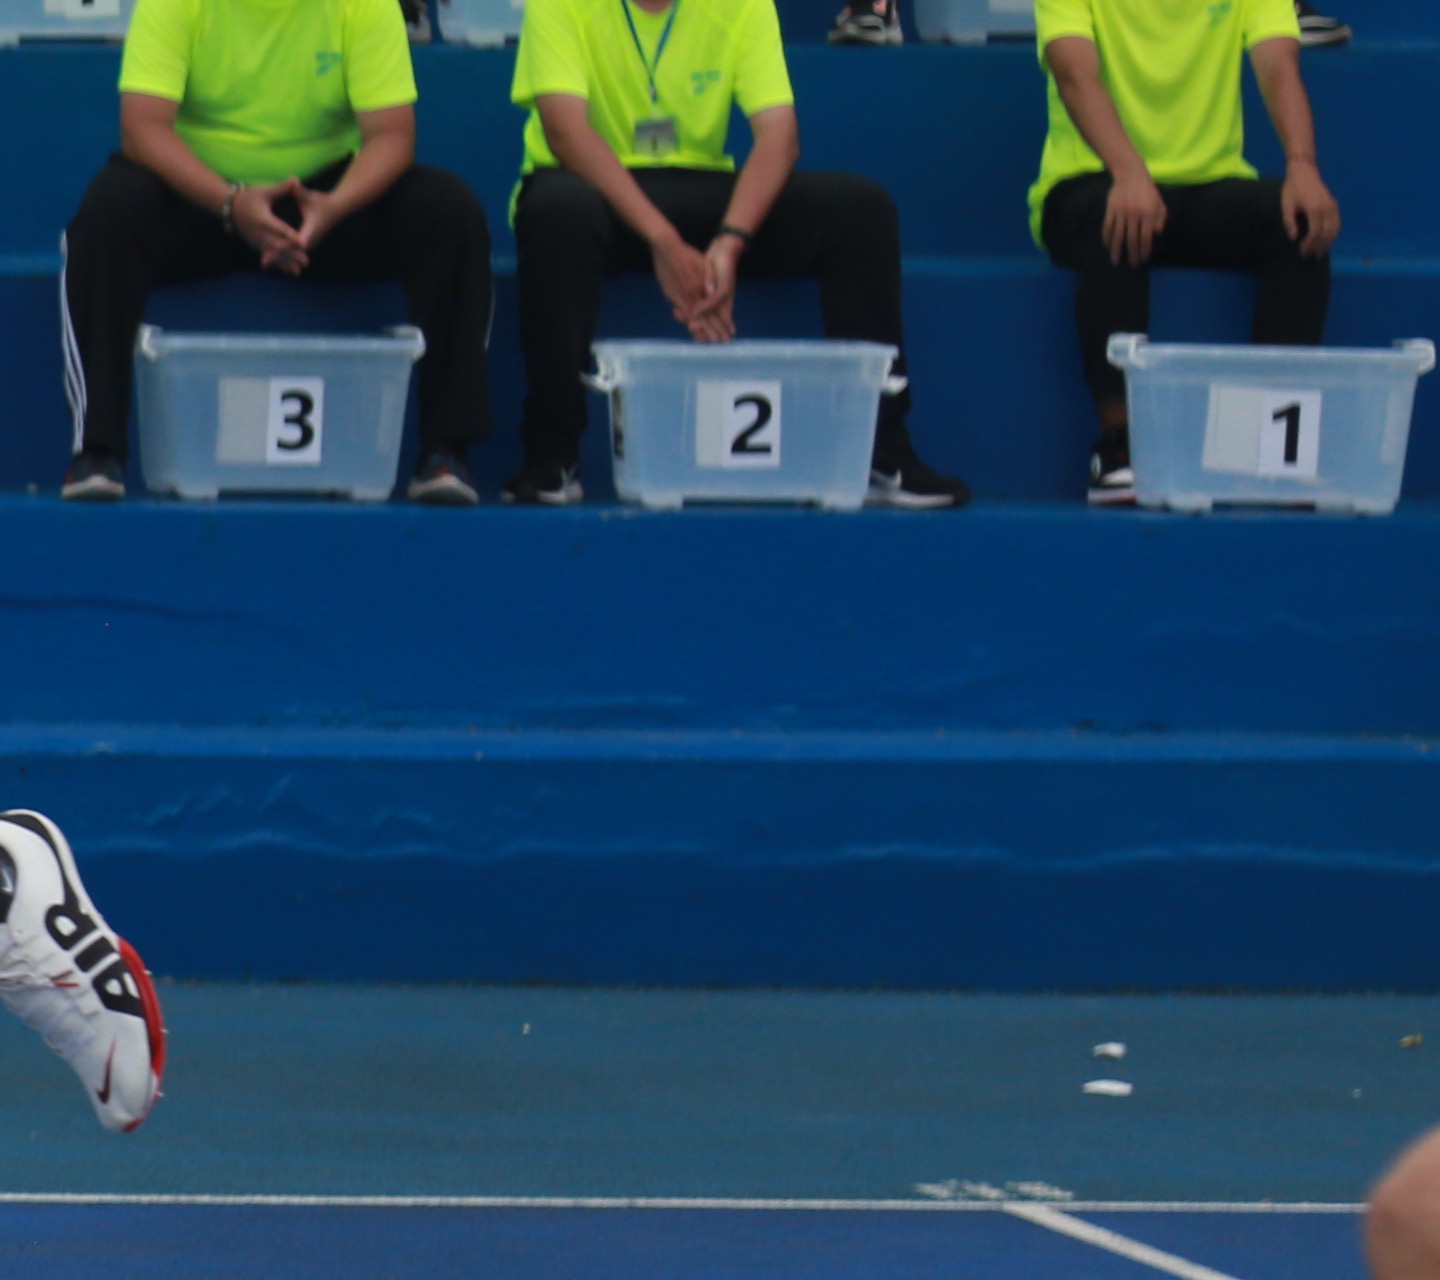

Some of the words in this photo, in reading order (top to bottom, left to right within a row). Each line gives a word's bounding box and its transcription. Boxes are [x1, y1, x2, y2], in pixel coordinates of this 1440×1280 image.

[277, 389, 315, 451] 3
[730, 393, 772, 454] 2
[1272, 402, 1301, 464] 1
[44, 872, 145, 1018] AIR
